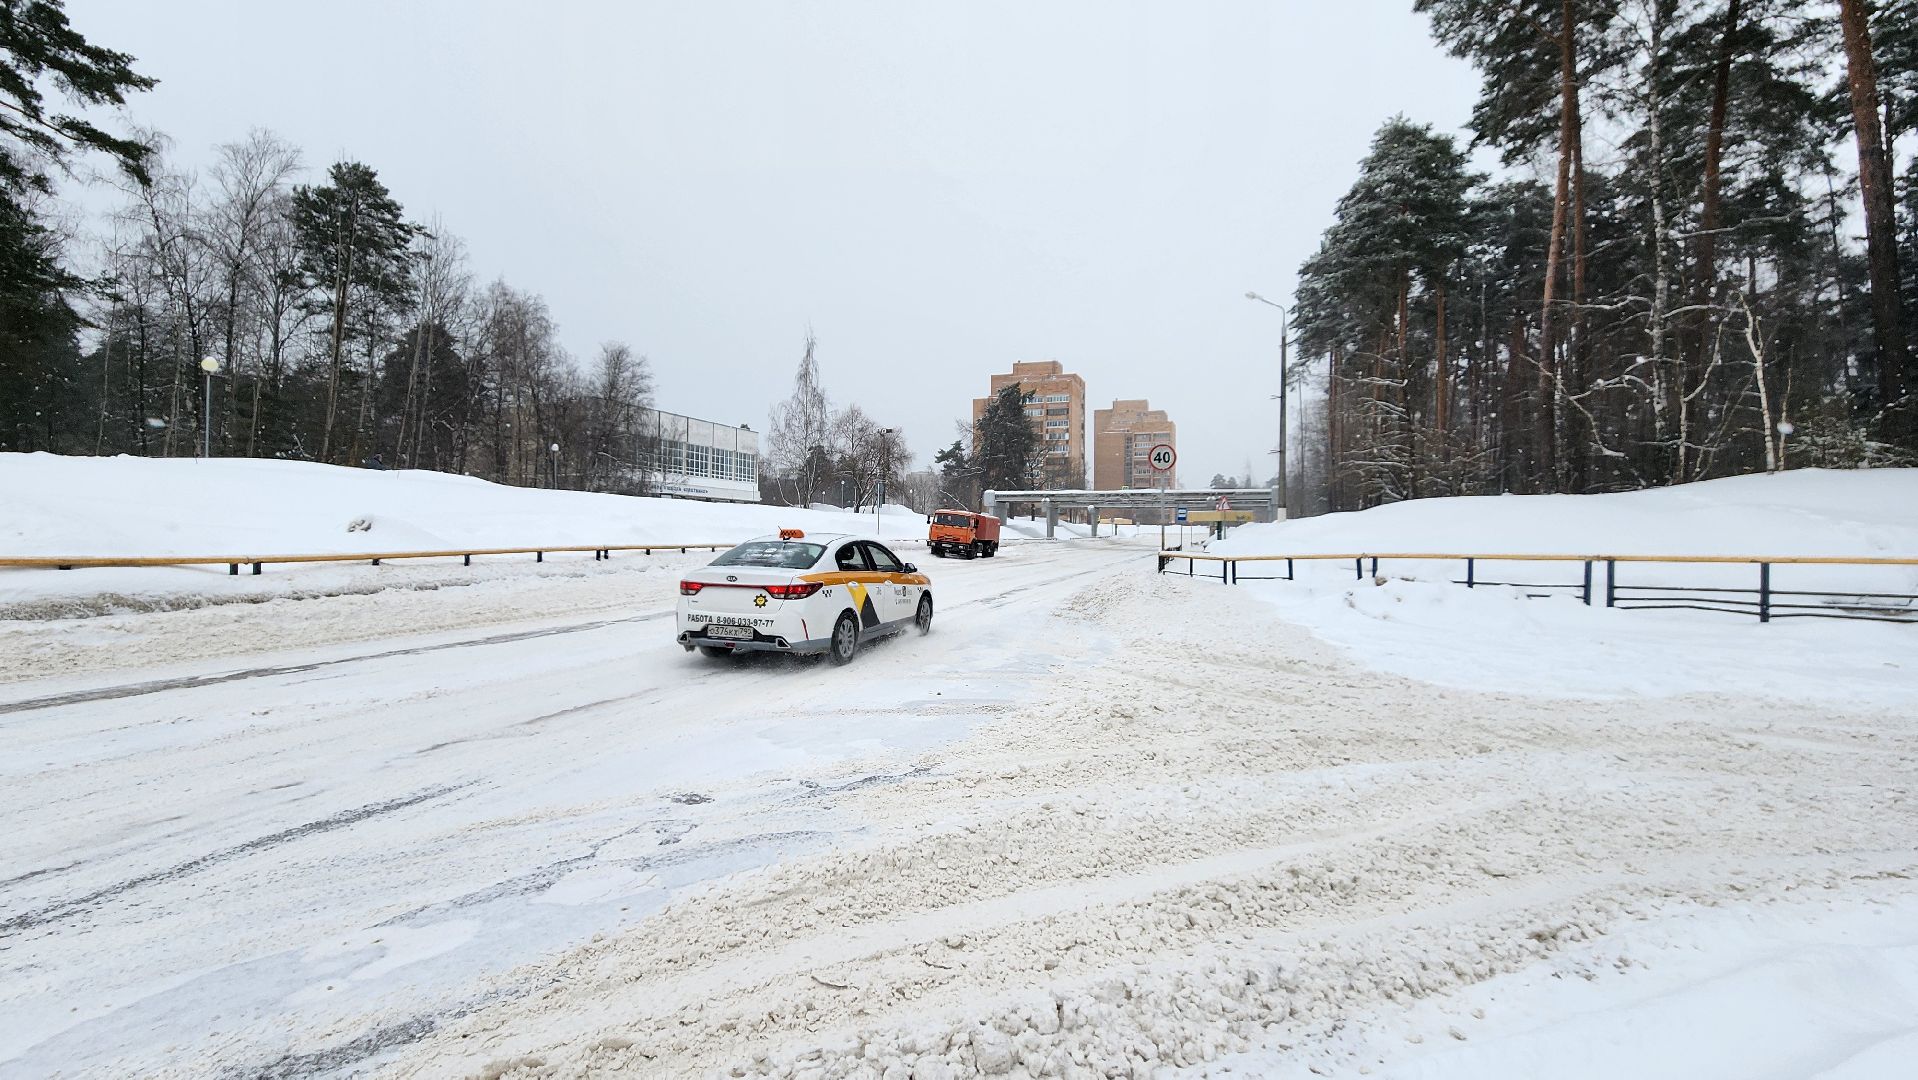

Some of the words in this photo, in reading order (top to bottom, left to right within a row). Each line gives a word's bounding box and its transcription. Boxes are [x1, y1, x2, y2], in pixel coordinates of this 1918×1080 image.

[1153, 451, 1171, 464] 40
[688, 614, 713, 623] РАБОТА
[716, 616, 774, 627] 8-906-033-97-77
